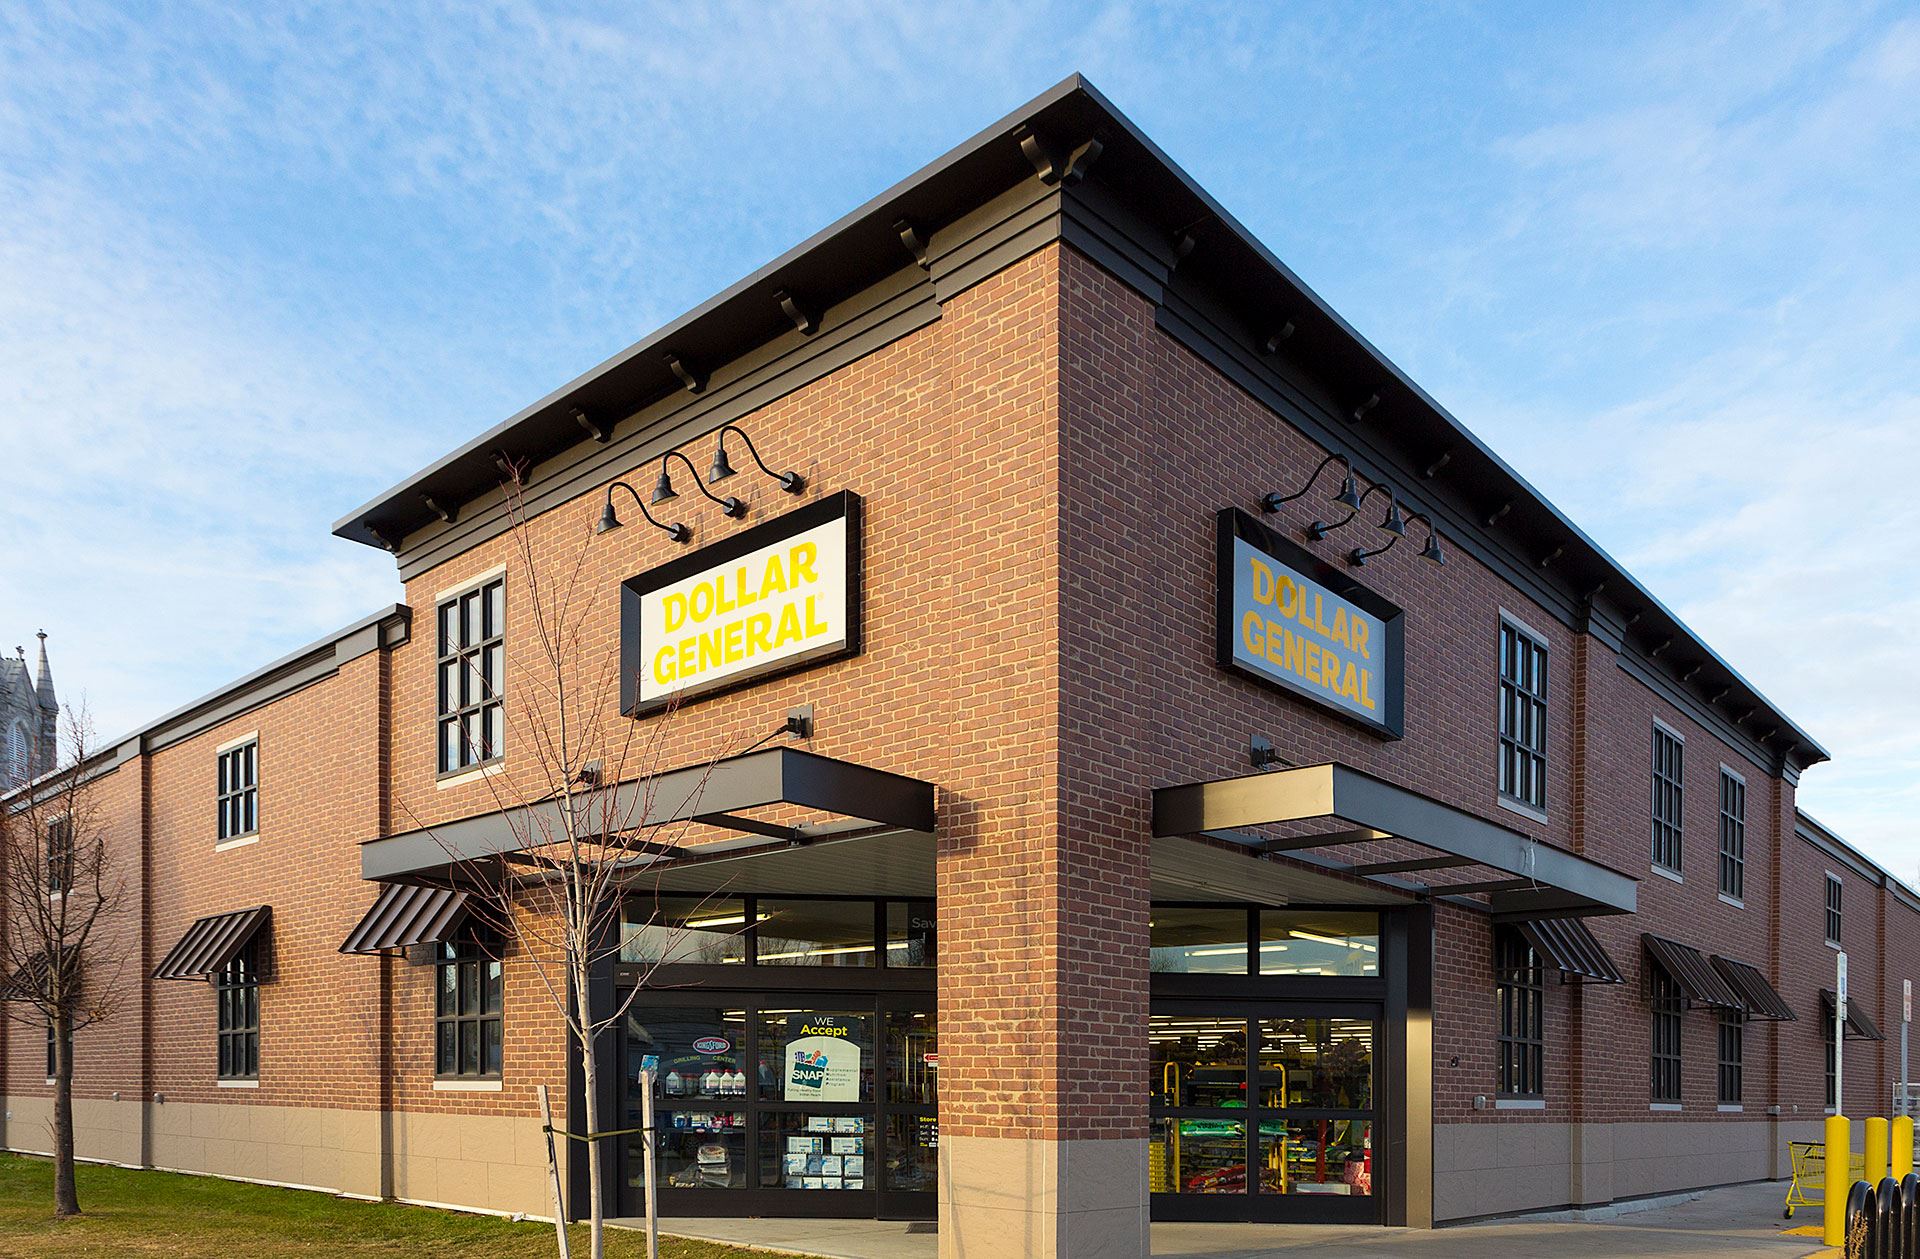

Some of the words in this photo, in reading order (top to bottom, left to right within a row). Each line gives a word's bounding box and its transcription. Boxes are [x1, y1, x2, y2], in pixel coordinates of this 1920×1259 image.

[662, 541, 819, 634] DOLLAR
[1250, 557, 1370, 660] DOLLAR
[653, 595, 828, 685] GENERAL
[1242, 610, 1375, 710] GENERAL
[800, 1024, 848, 1038] Accept
[814, 1016, 834, 1026] WE
[792, 1070, 824, 1081] SNAP
